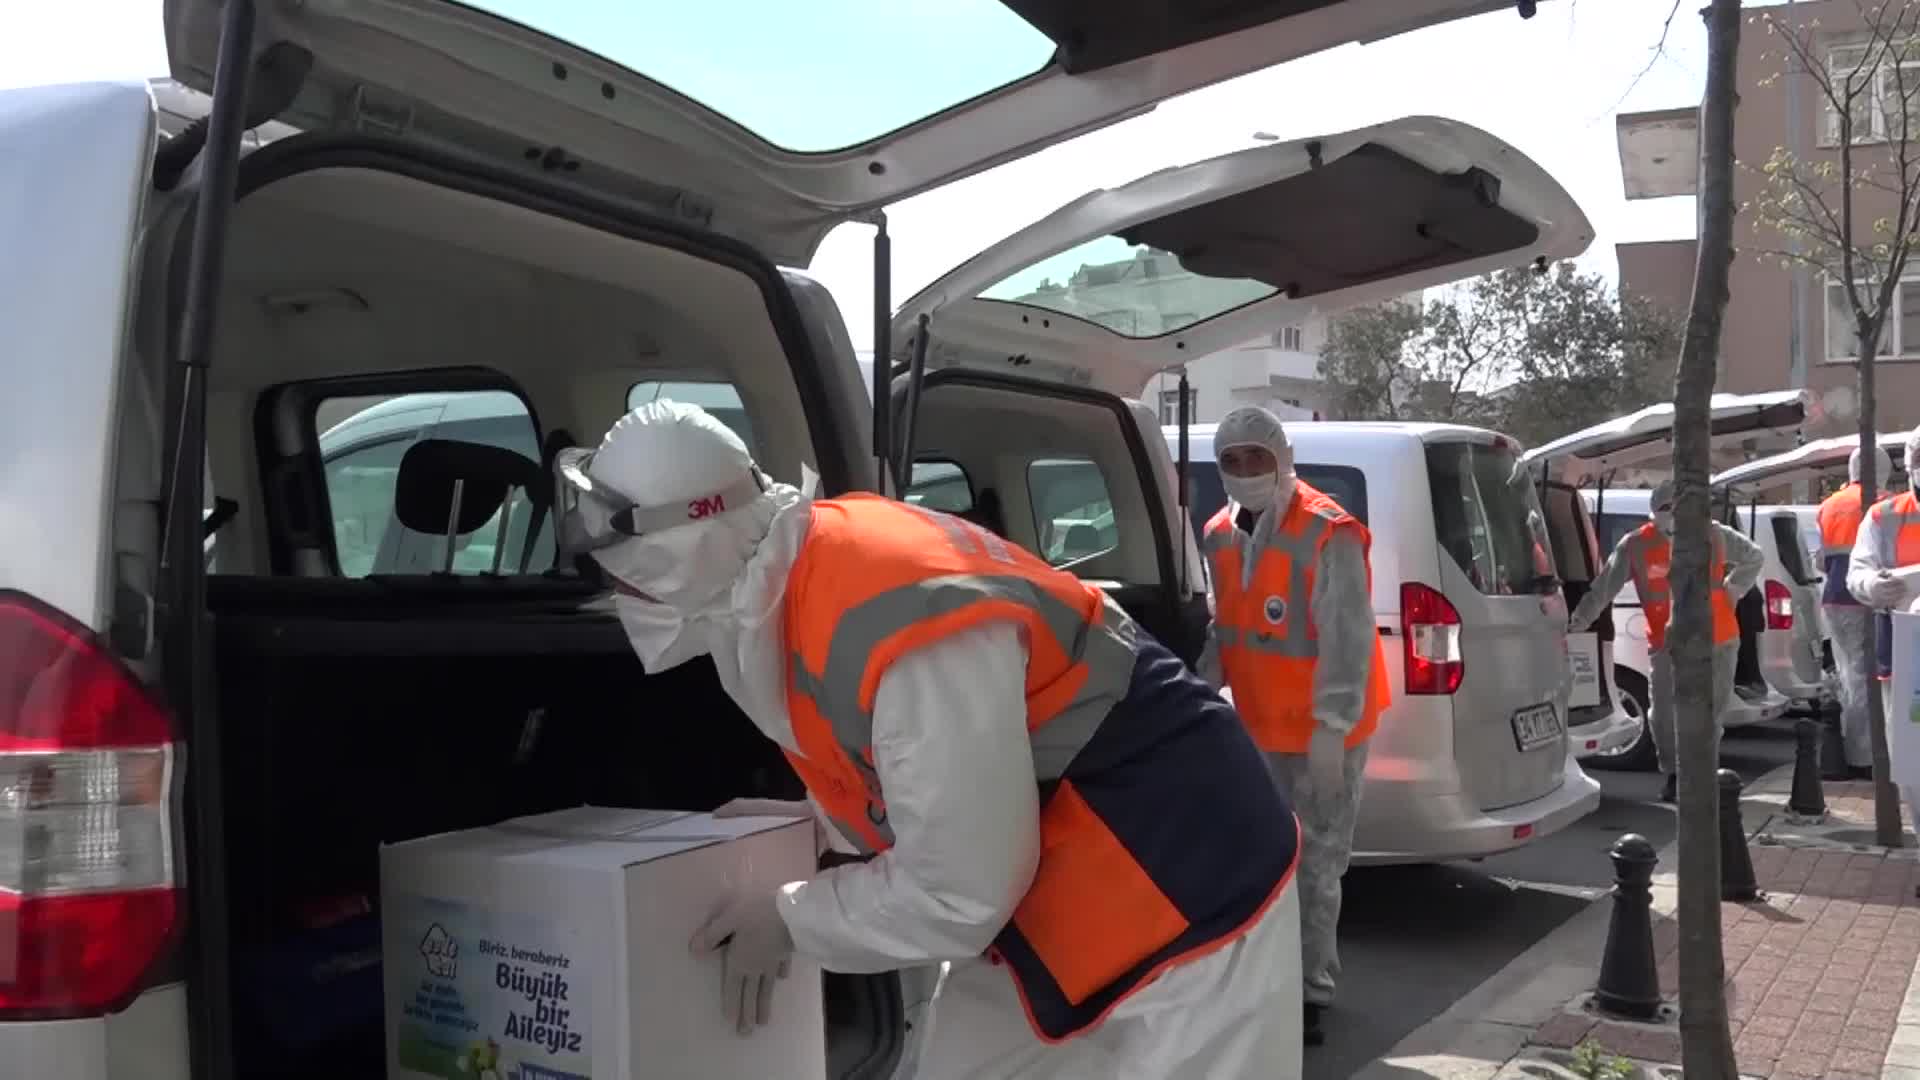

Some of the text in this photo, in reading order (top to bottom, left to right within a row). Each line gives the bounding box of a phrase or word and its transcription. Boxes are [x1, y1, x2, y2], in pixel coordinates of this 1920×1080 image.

[687, 494, 726, 519] 3M
[495, 962, 569, 1002] Büyük
[535, 997, 571, 1026] bir
[503, 1010, 583, 1055] Aileyiz
